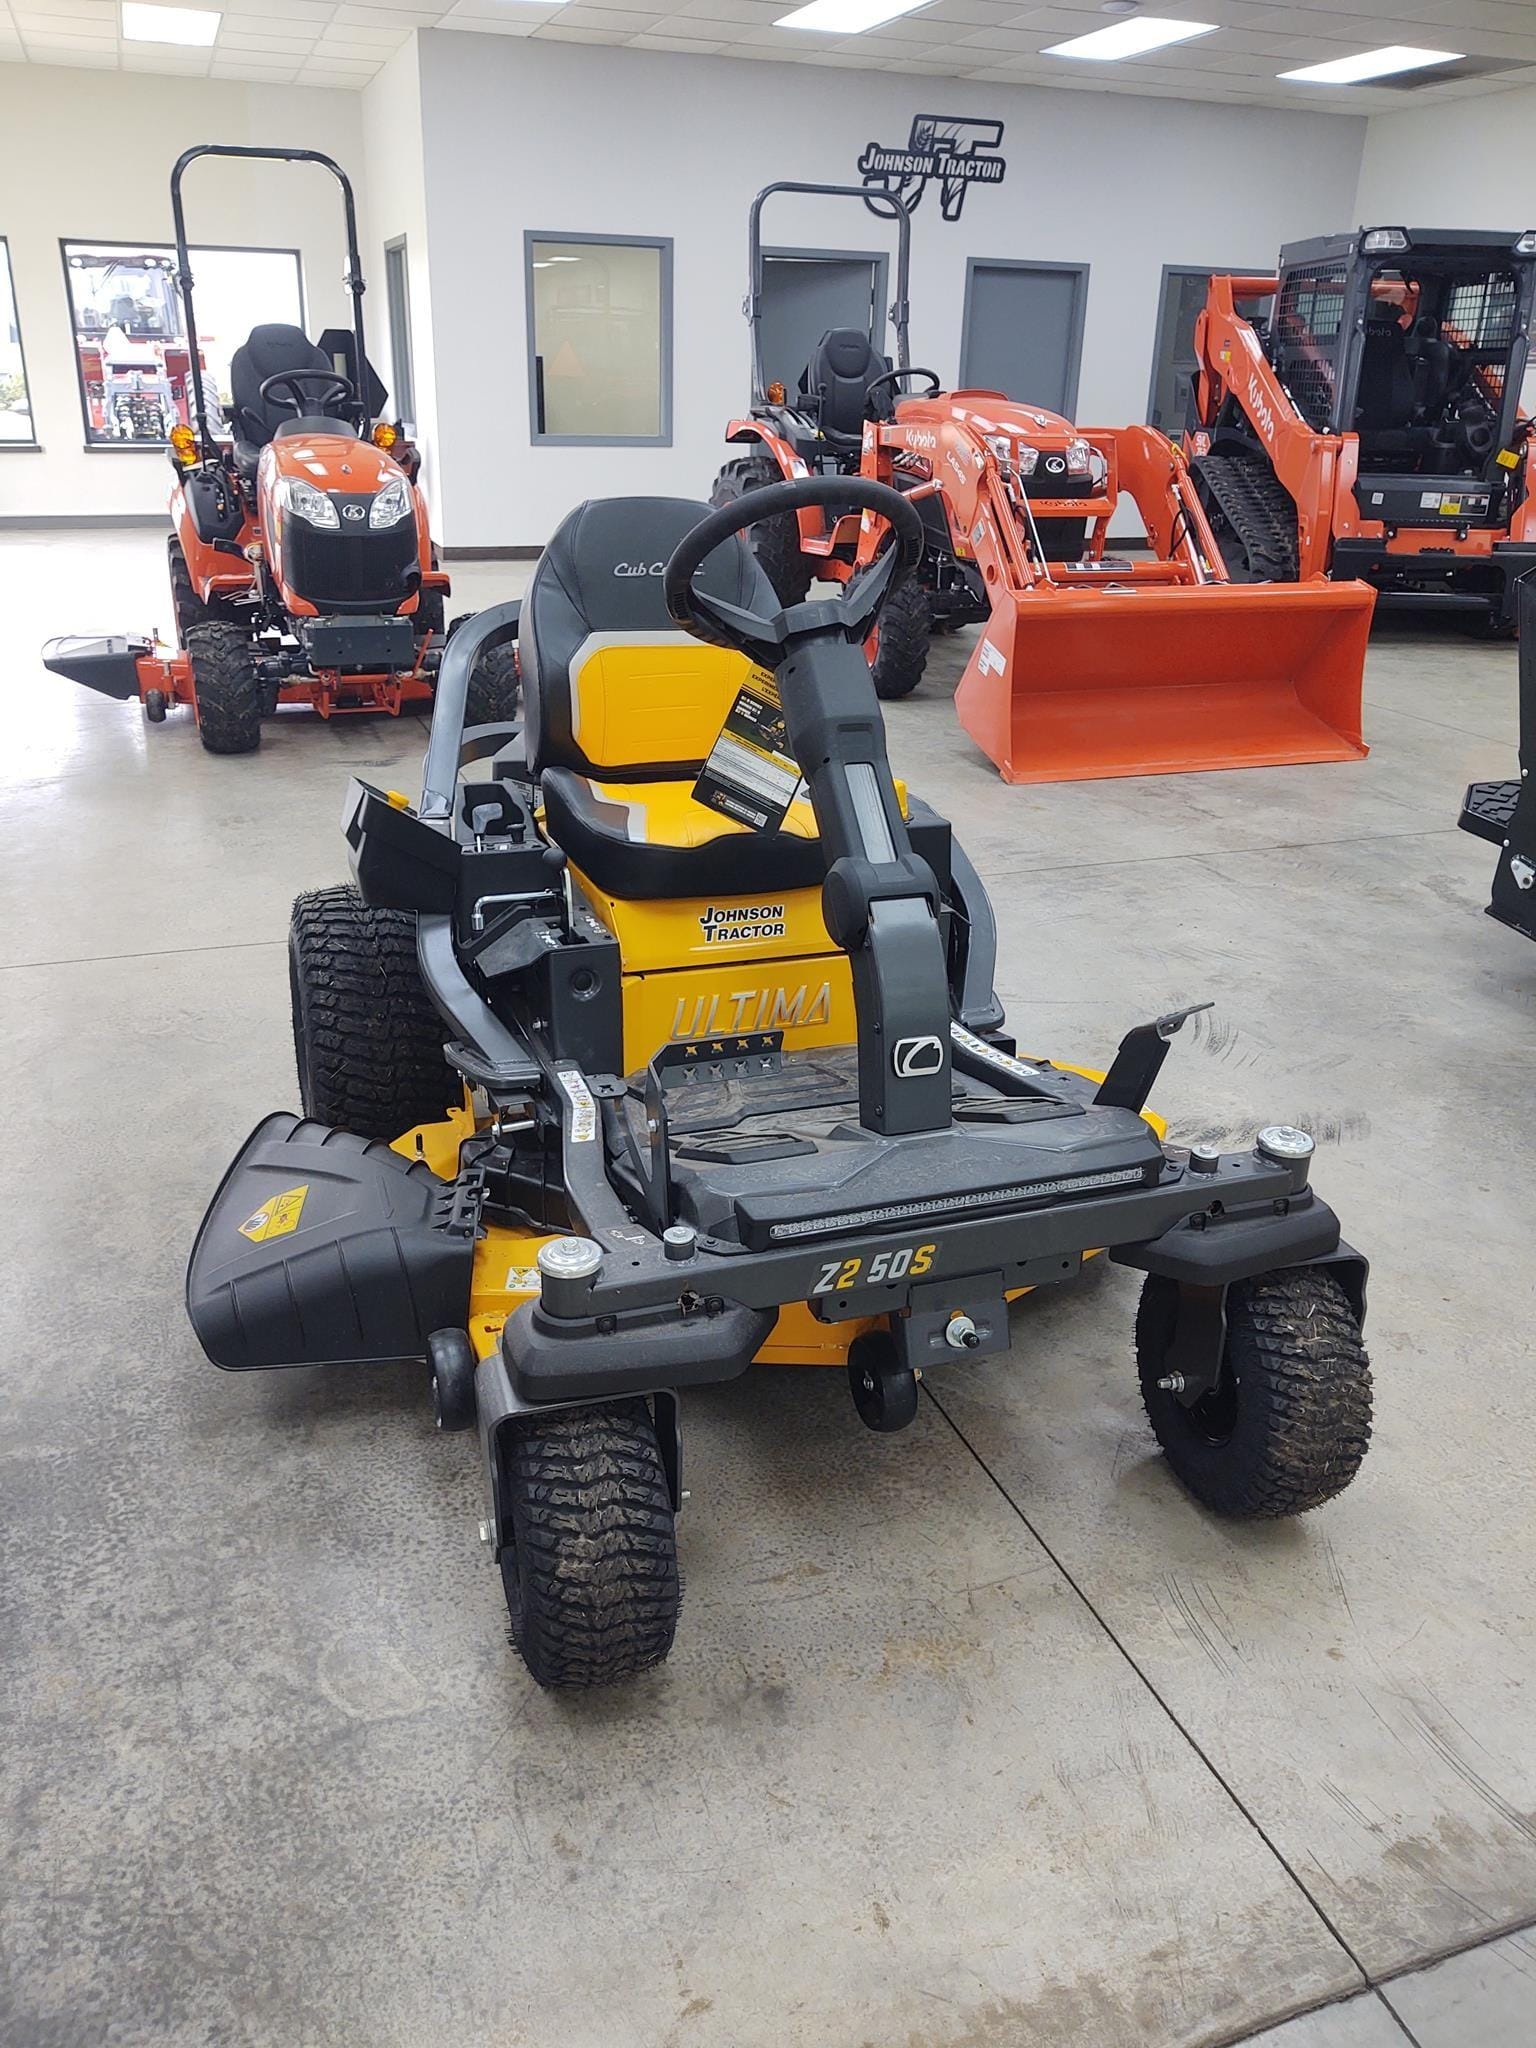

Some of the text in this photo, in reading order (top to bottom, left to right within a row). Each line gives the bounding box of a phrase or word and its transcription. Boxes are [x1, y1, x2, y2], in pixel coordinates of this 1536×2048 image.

[862, 147, 1002, 179] JOHNSON TRACTOR
[1248, 372, 1275, 442] Kubota
[905, 428, 937, 450] Kubota
[613, 562, 647, 577] Cub
[699, 905, 784, 925] JOHNSON
[702, 922, 785, 943] TRACTOR
[670, 981, 831, 1041] ULTIMA
[812, 1244, 937, 1294] Z2 50S
